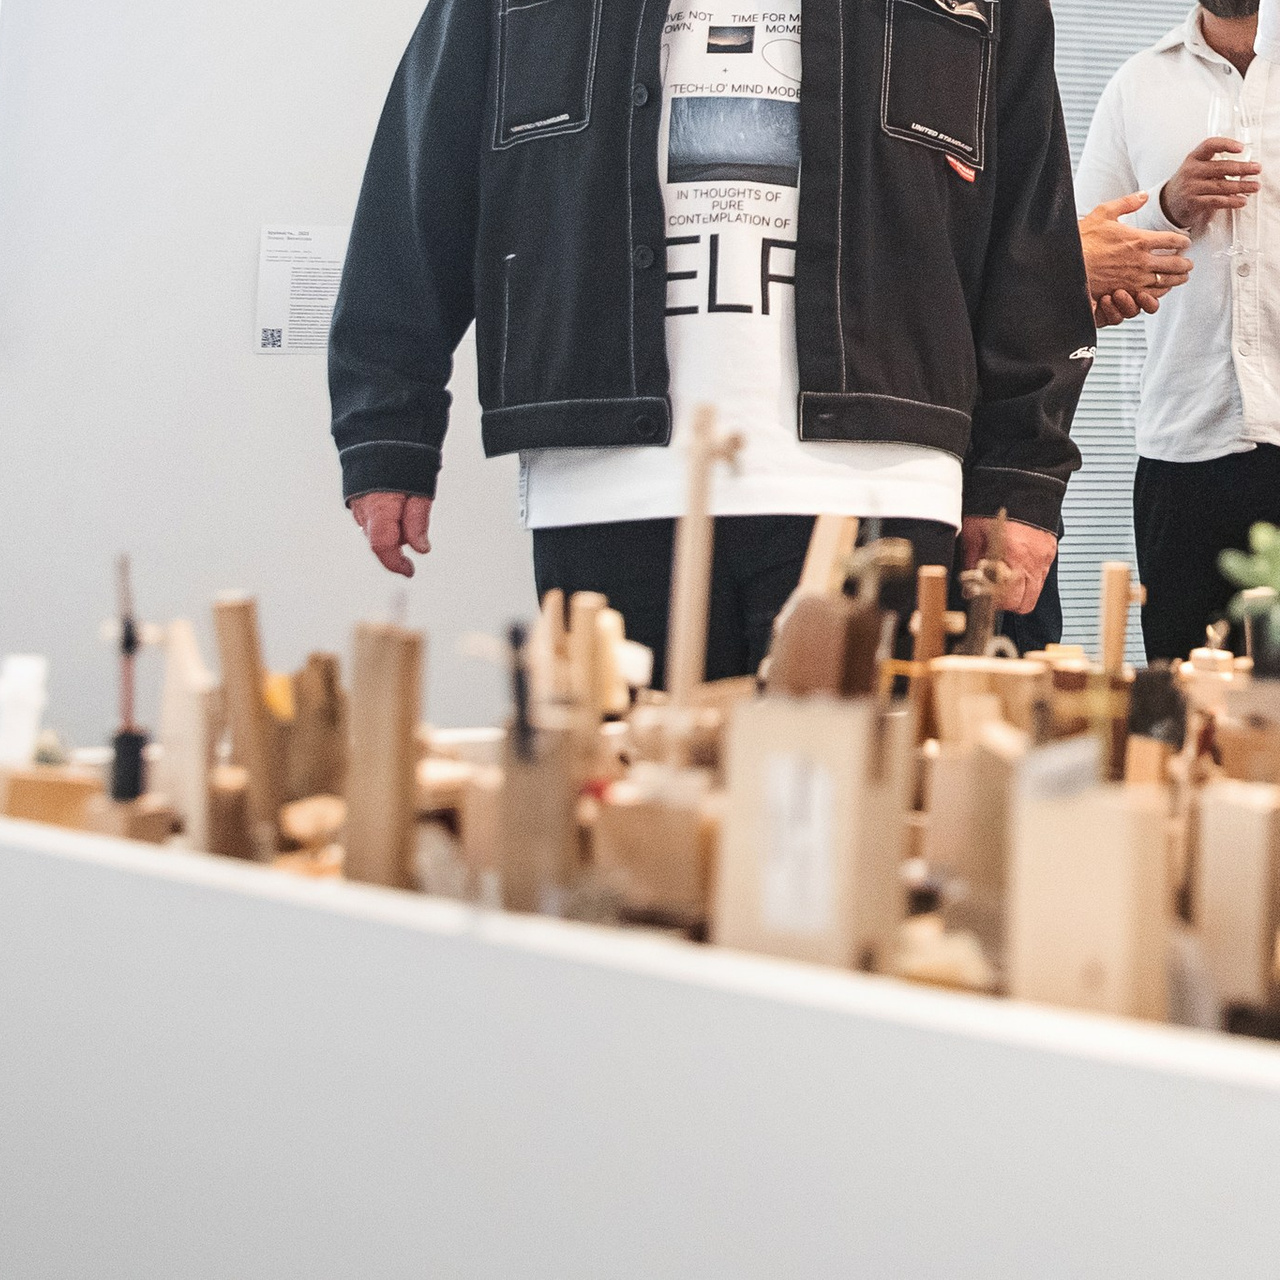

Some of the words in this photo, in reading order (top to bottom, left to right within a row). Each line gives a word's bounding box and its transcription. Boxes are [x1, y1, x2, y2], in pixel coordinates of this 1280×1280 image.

[689, 10, 714, 22] NOT
[732, 13, 759, 23] TIME
[762, 12, 786, 22] FOR
[789, 13, 801, 23] M
[731, 83, 764, 95] MIND
[911, 123, 938, 136] UNITED
[677, 189, 688, 200] IN
[693, 188, 761, 200] THOUGHTS
[765, 191, 782, 202] OF
[712, 200, 744, 211] PURE
[668, 213, 770, 227] CONTEMPLATION
[774, 217, 791, 229] OF
